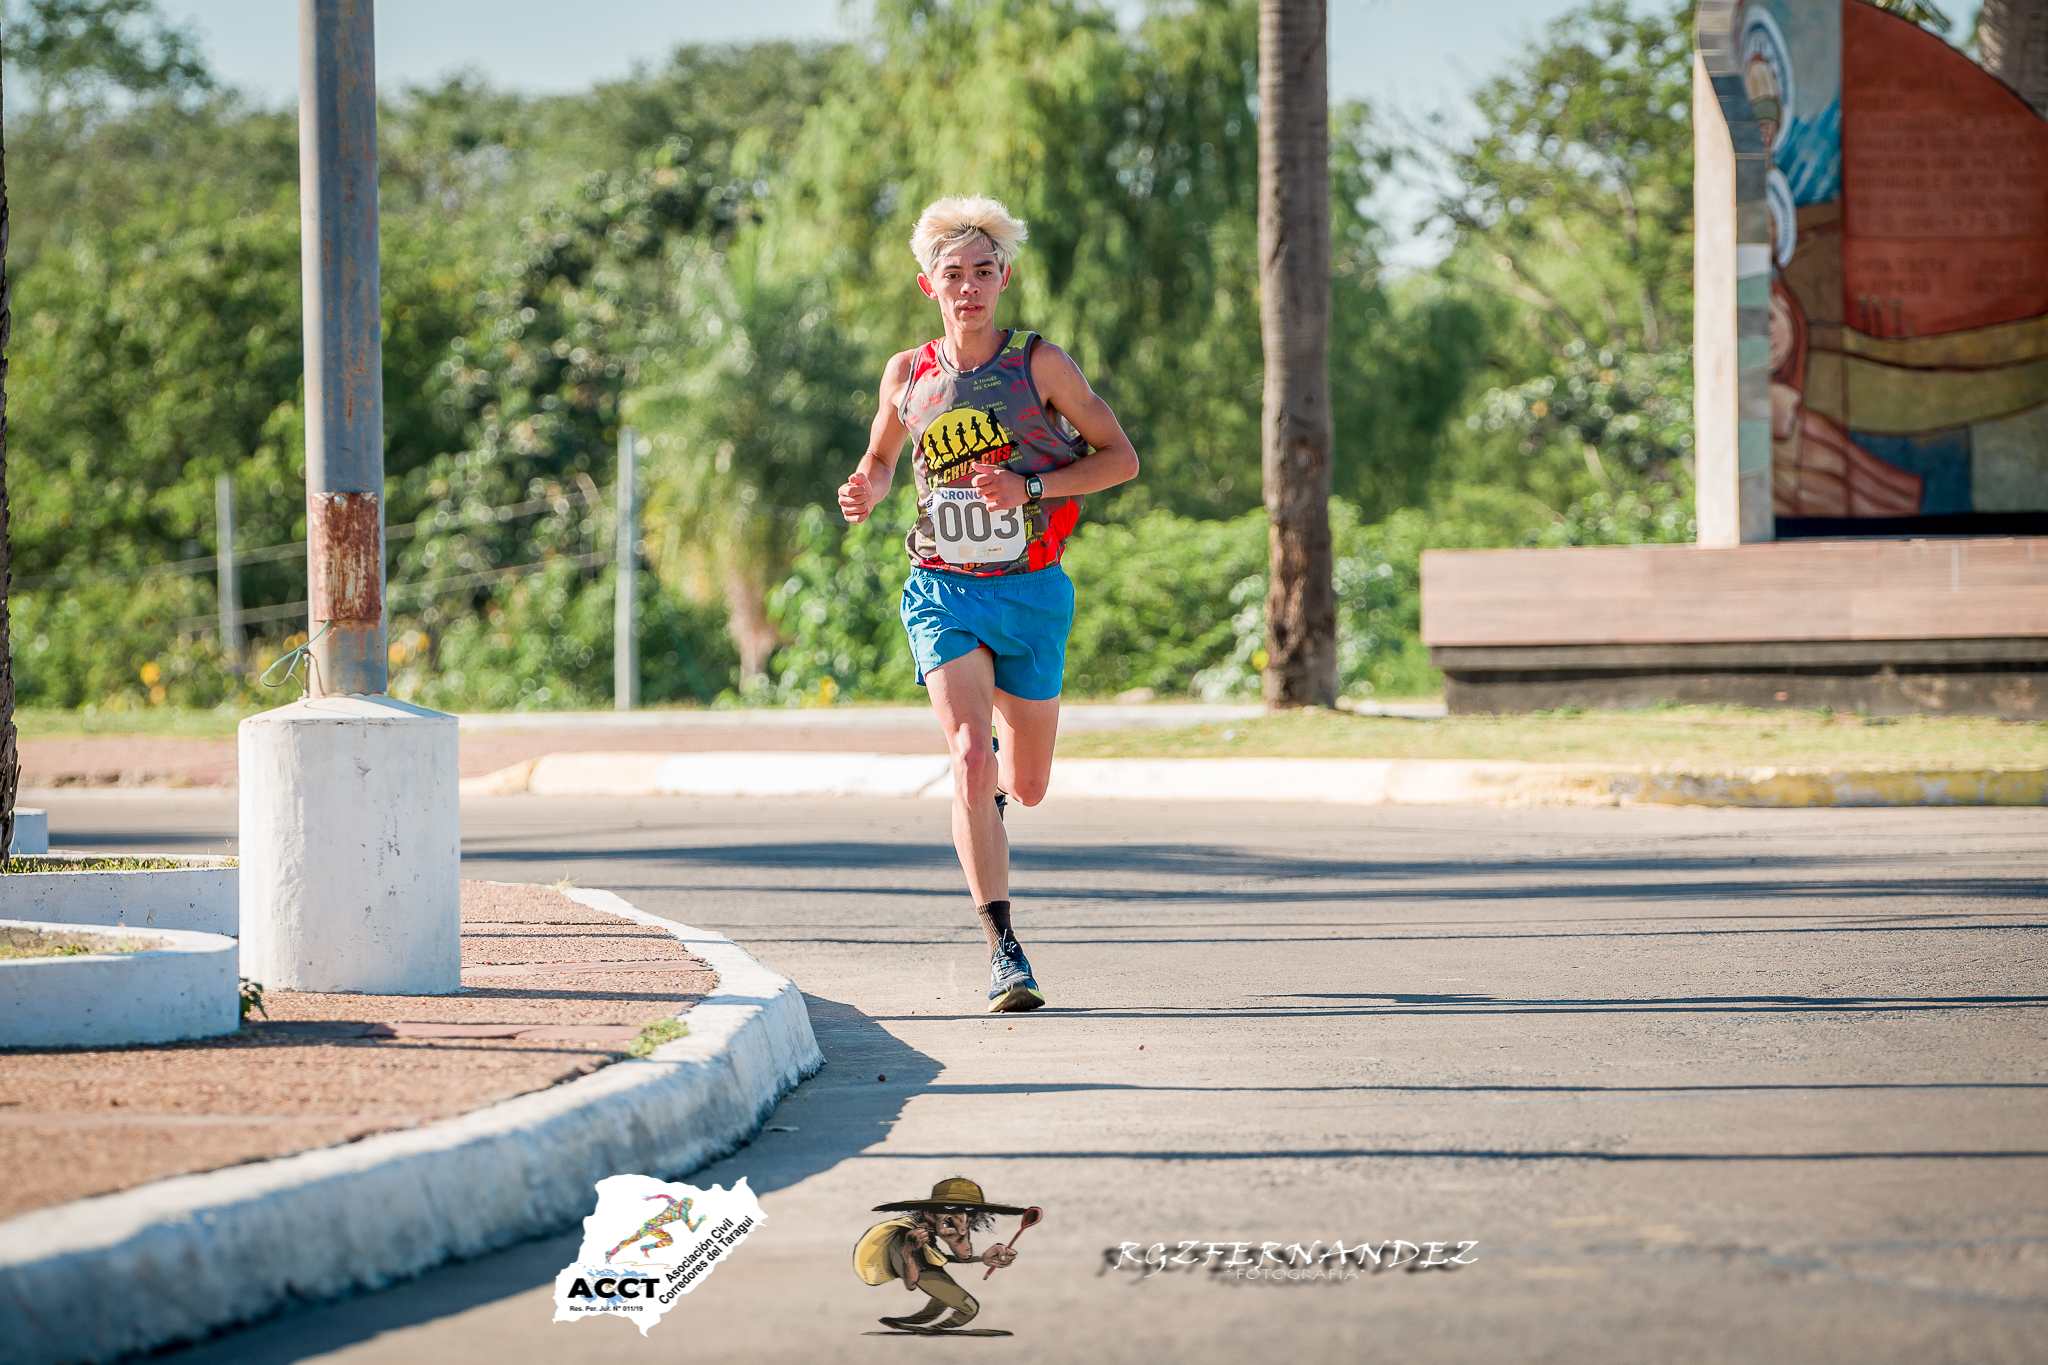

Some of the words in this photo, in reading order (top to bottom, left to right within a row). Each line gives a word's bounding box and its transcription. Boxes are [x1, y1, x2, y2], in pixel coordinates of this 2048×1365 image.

[979, 375, 997, 384] TRAVÉS
[983, 380, 1002, 389] CAMPO
[985, 400, 1003, 409] TRAVÉS
[981, 444, 1011, 466] CTES
[1007, 455, 1023, 464] CAMPO
[937, 501, 1020, 543] 003
